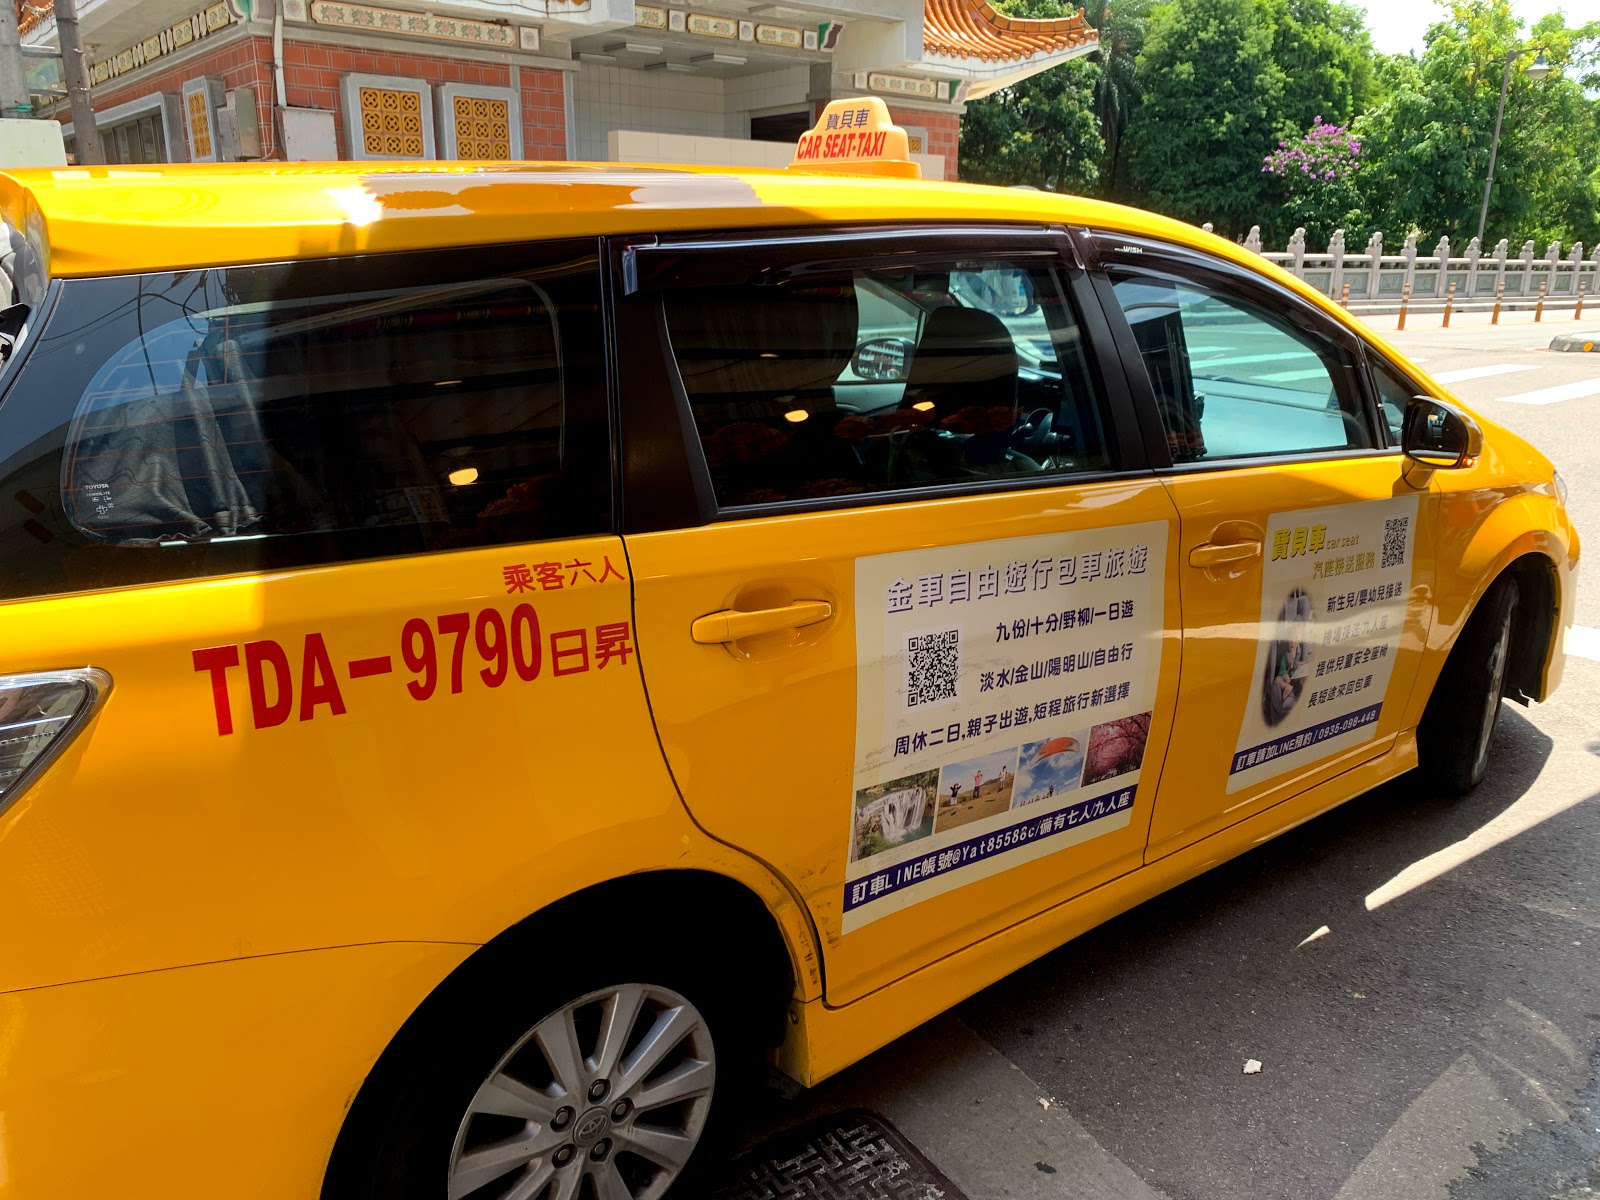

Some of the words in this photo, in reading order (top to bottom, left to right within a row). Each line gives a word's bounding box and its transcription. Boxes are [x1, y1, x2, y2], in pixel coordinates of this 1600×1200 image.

[825, 108, 870, 131] 寶貝車
[797, 134, 823, 159] CAR
[823, 131, 887, 158] SEAT-TAXI
[1123, 245, 1143, 254] WISH
[1272, 524, 1328, 561] 寶貝車
[503, 555, 626, 594] 乘客六人
[886, 543, 1149, 614] 金車自由遊行包車旅遊
[192, 602, 543, 737] TDA-9790
[550, 621, 634, 676] 日昇
